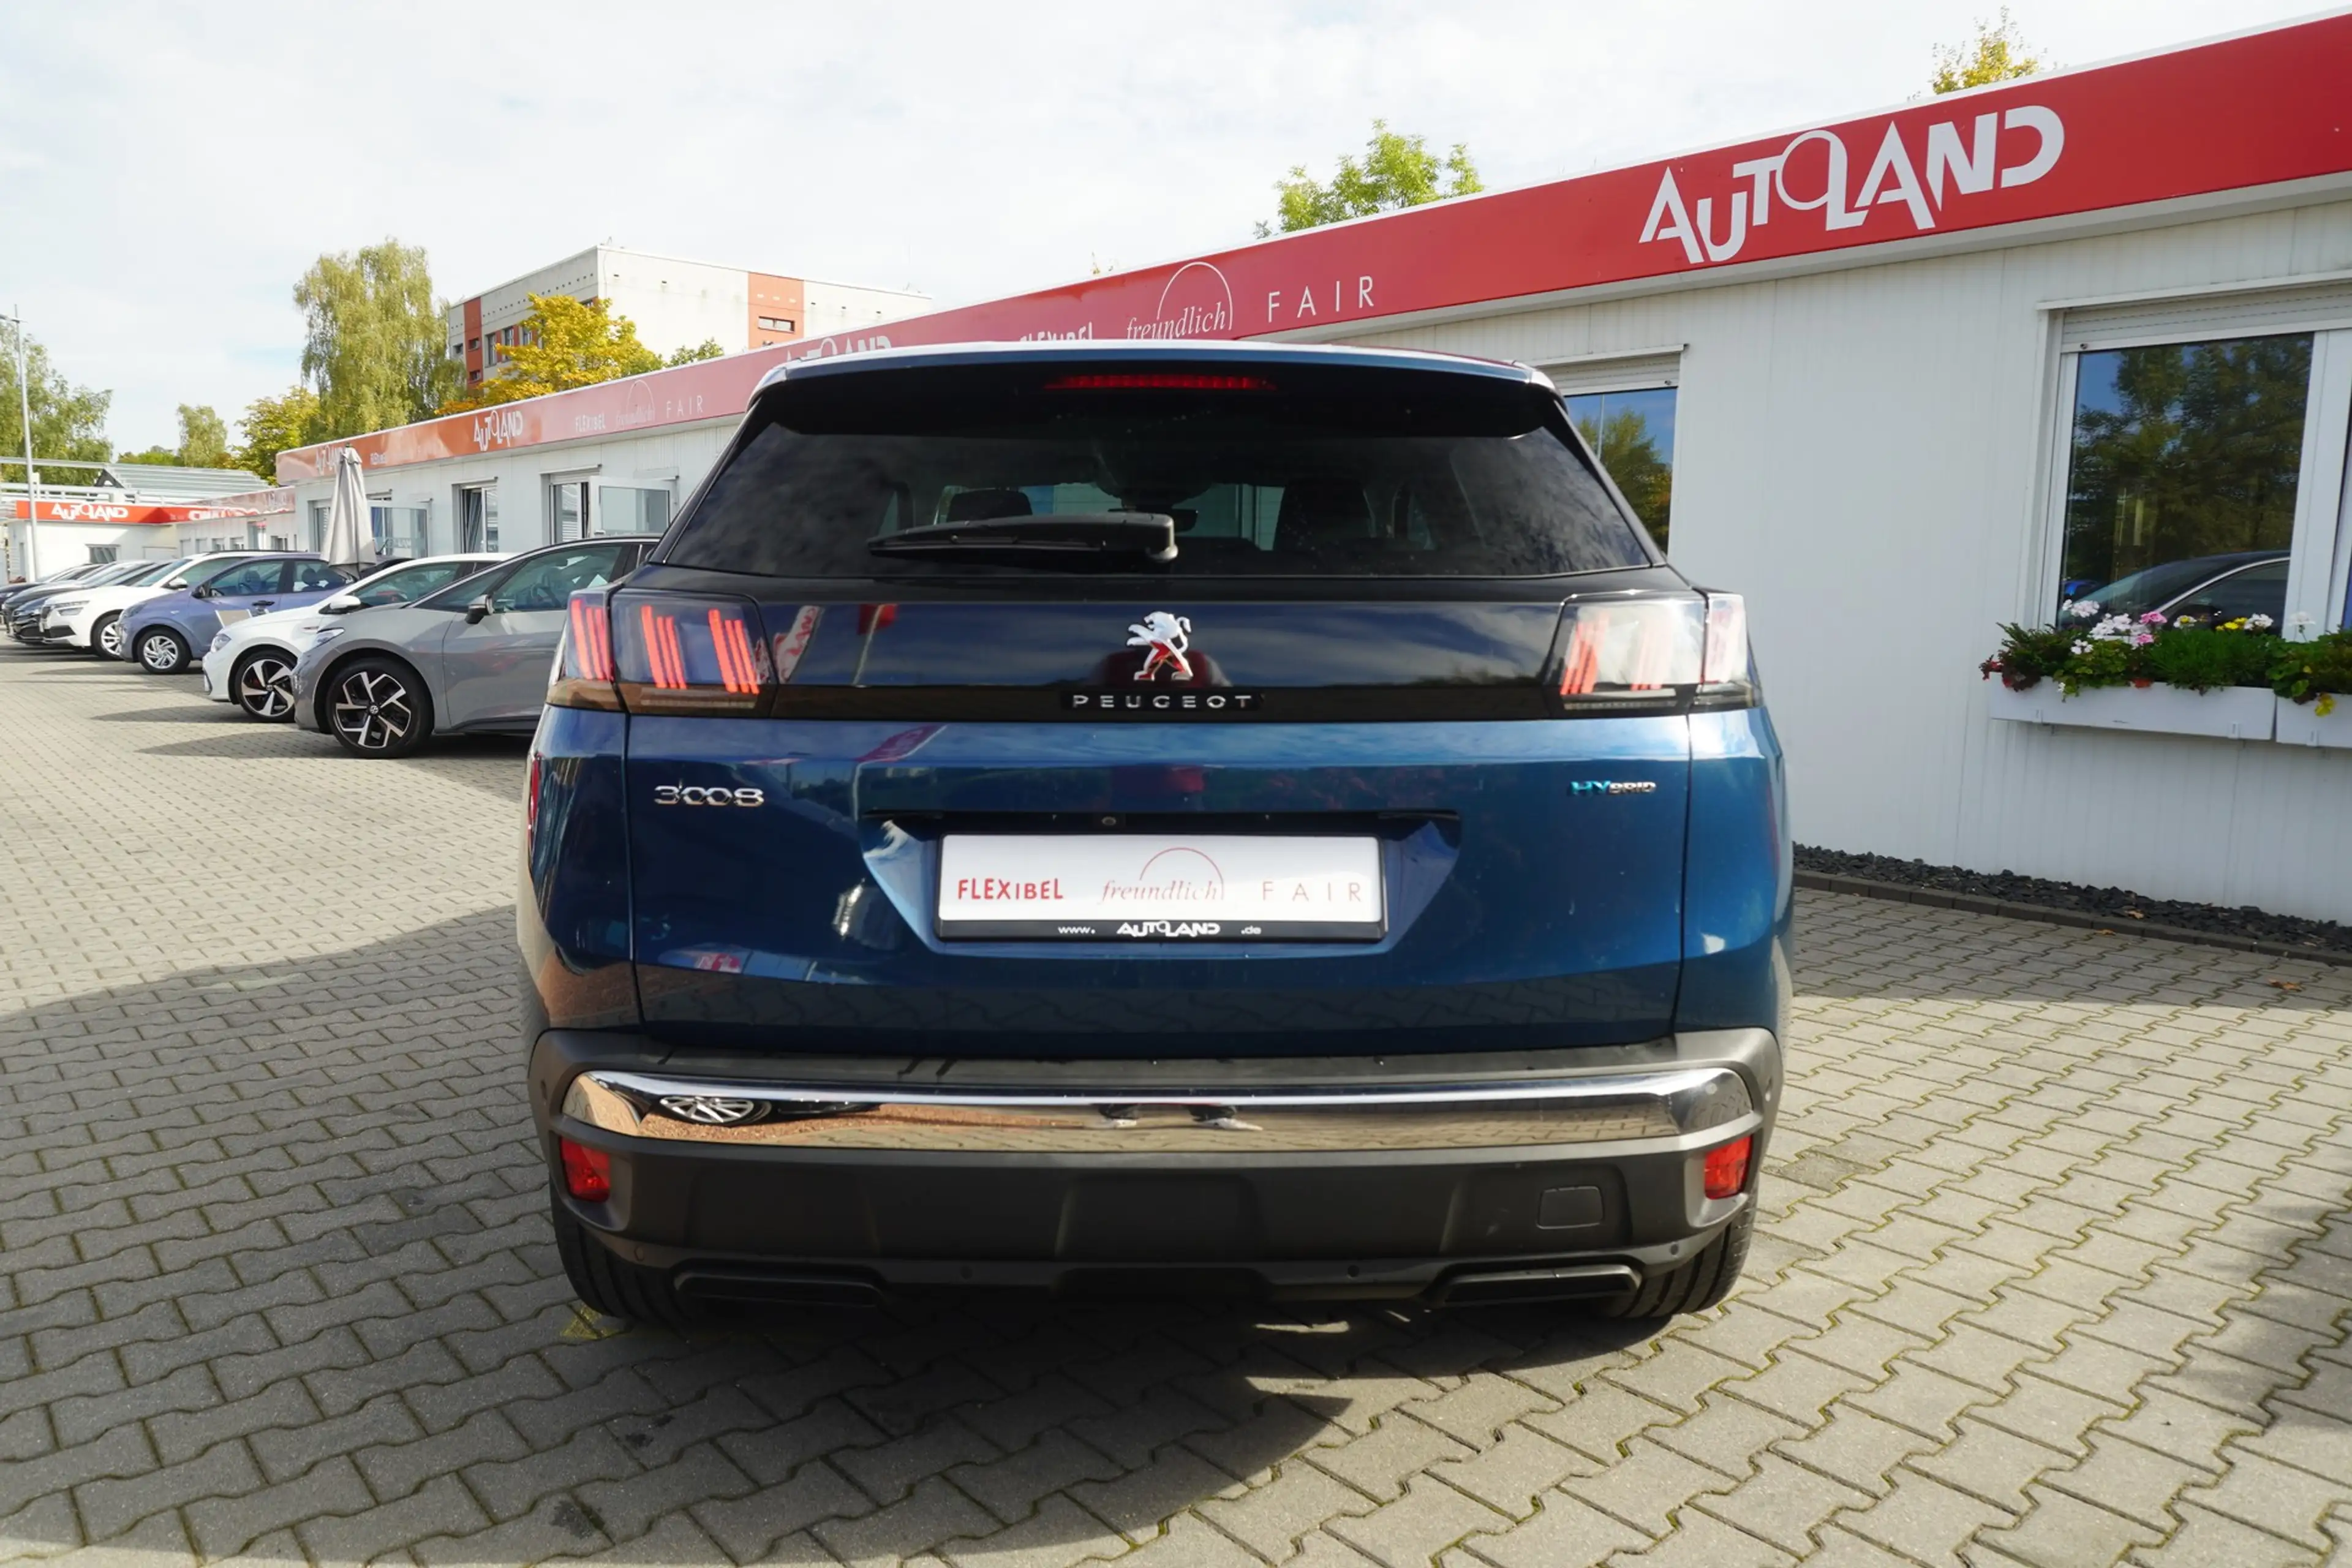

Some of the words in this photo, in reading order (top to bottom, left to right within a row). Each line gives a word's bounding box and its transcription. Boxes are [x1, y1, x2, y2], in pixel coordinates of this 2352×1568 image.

[1127, 301, 1226, 340] freundlich
[1267, 275, 1374, 323] FAIR
[666, 395, 704, 420] FAIR
[1072, 694, 1252, 709] PEUGEOT
[654, 785, 765, 807] 3008
[1570, 780, 1657, 794] HYBRID
[958, 877, 1064, 900] FLEXIBEL
[1100, 880, 1218, 905] freundlich
[1262, 880, 1362, 902] FAIR
[1058, 925, 1096, 935] www.
